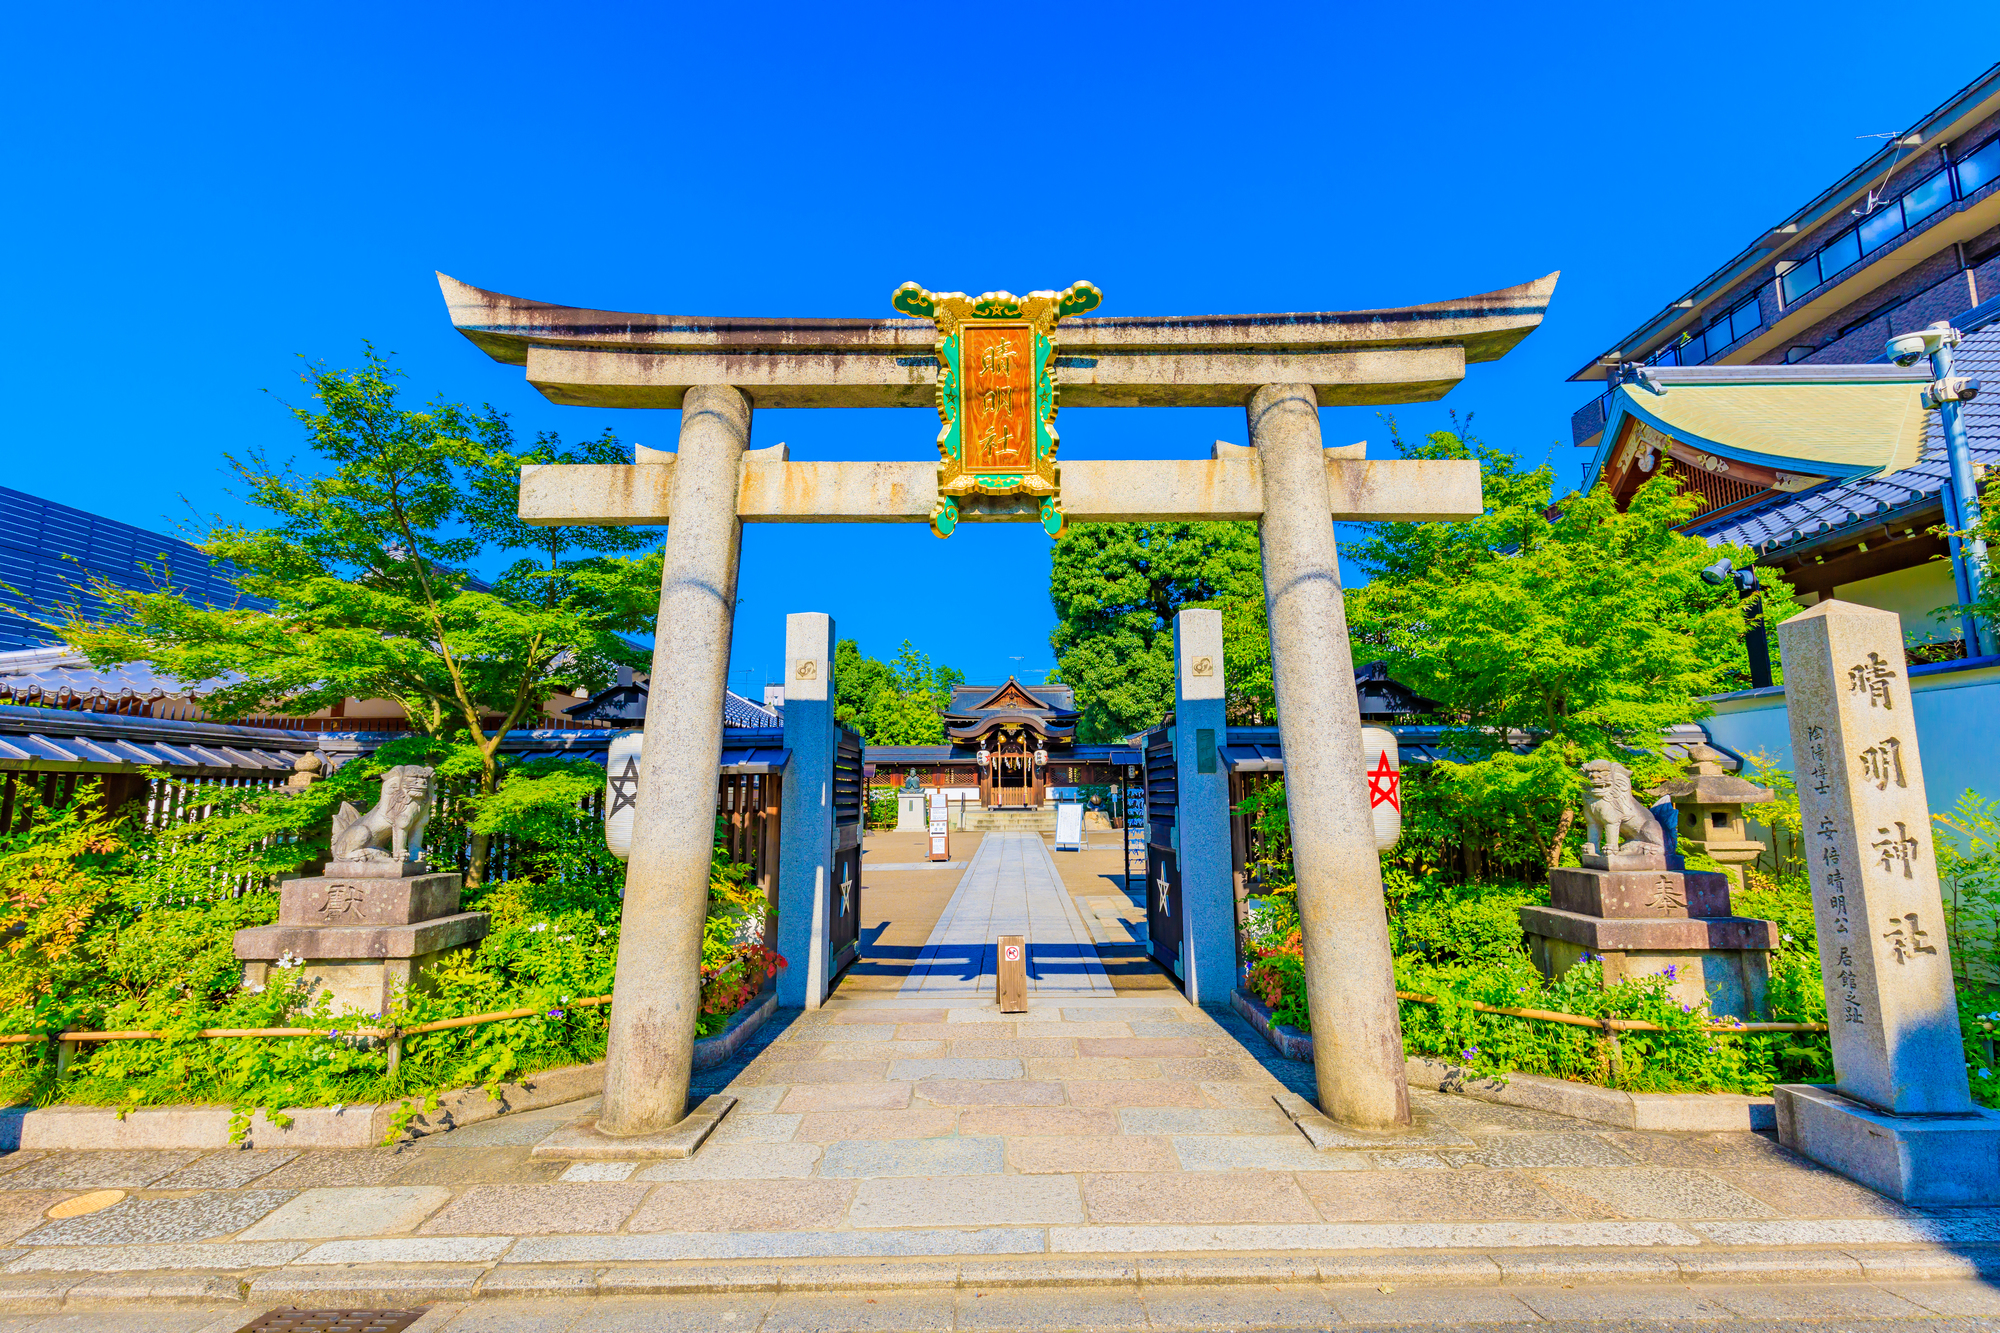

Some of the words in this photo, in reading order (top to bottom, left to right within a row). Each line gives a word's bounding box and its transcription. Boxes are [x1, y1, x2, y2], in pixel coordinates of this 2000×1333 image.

[1645, 875, 1688, 916] 奉
[1848, 651, 1937, 965] 晴明神社
